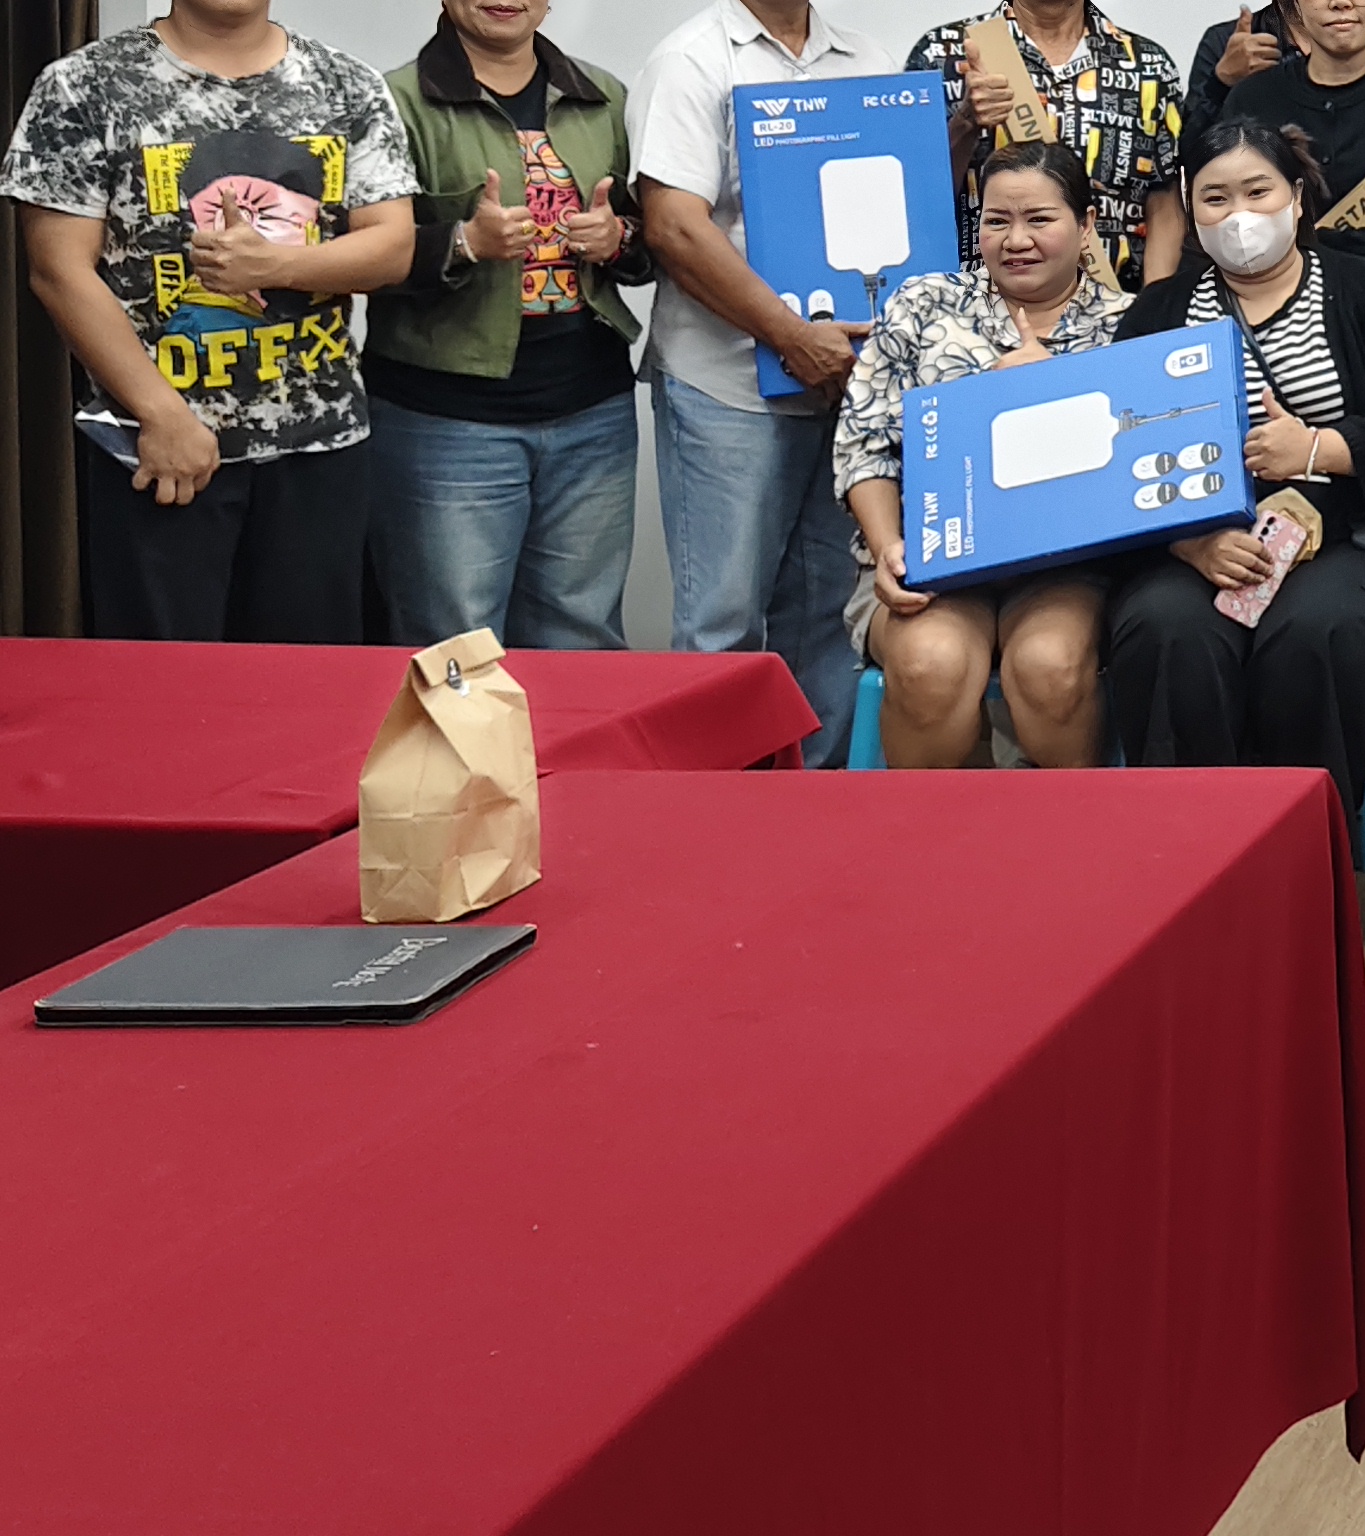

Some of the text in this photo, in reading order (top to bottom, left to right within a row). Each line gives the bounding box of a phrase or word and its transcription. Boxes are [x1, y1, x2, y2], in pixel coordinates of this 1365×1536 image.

[1101, 67, 1140, 91] KEG
[792, 96, 829, 113] TNW
[759, 122, 793, 133] RL-20
[754, 136, 775, 148] LED
[1113, 131, 1133, 186] PILSNER
[923, 492, 939, 525] TNW
[948, 521, 958, 553] RL-20
